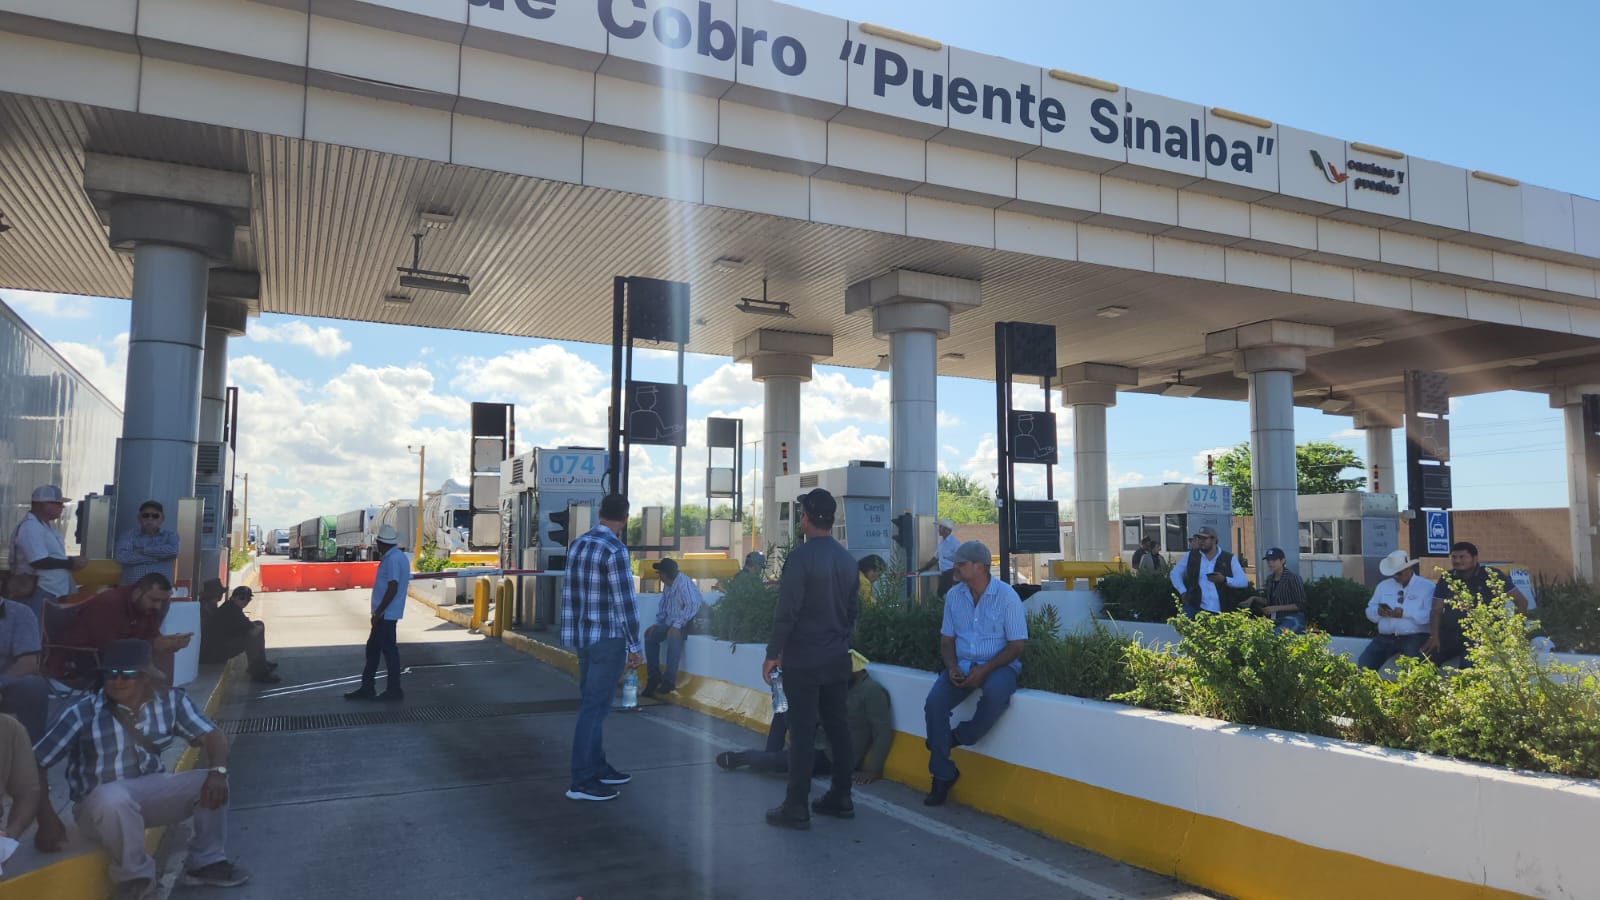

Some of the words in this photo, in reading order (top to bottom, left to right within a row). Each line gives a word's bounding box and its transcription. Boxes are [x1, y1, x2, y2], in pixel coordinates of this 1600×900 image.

[599, 0, 807, 76] Cobro
[549, 455, 595, 475] 074
[1193, 488, 1217, 502] 074
